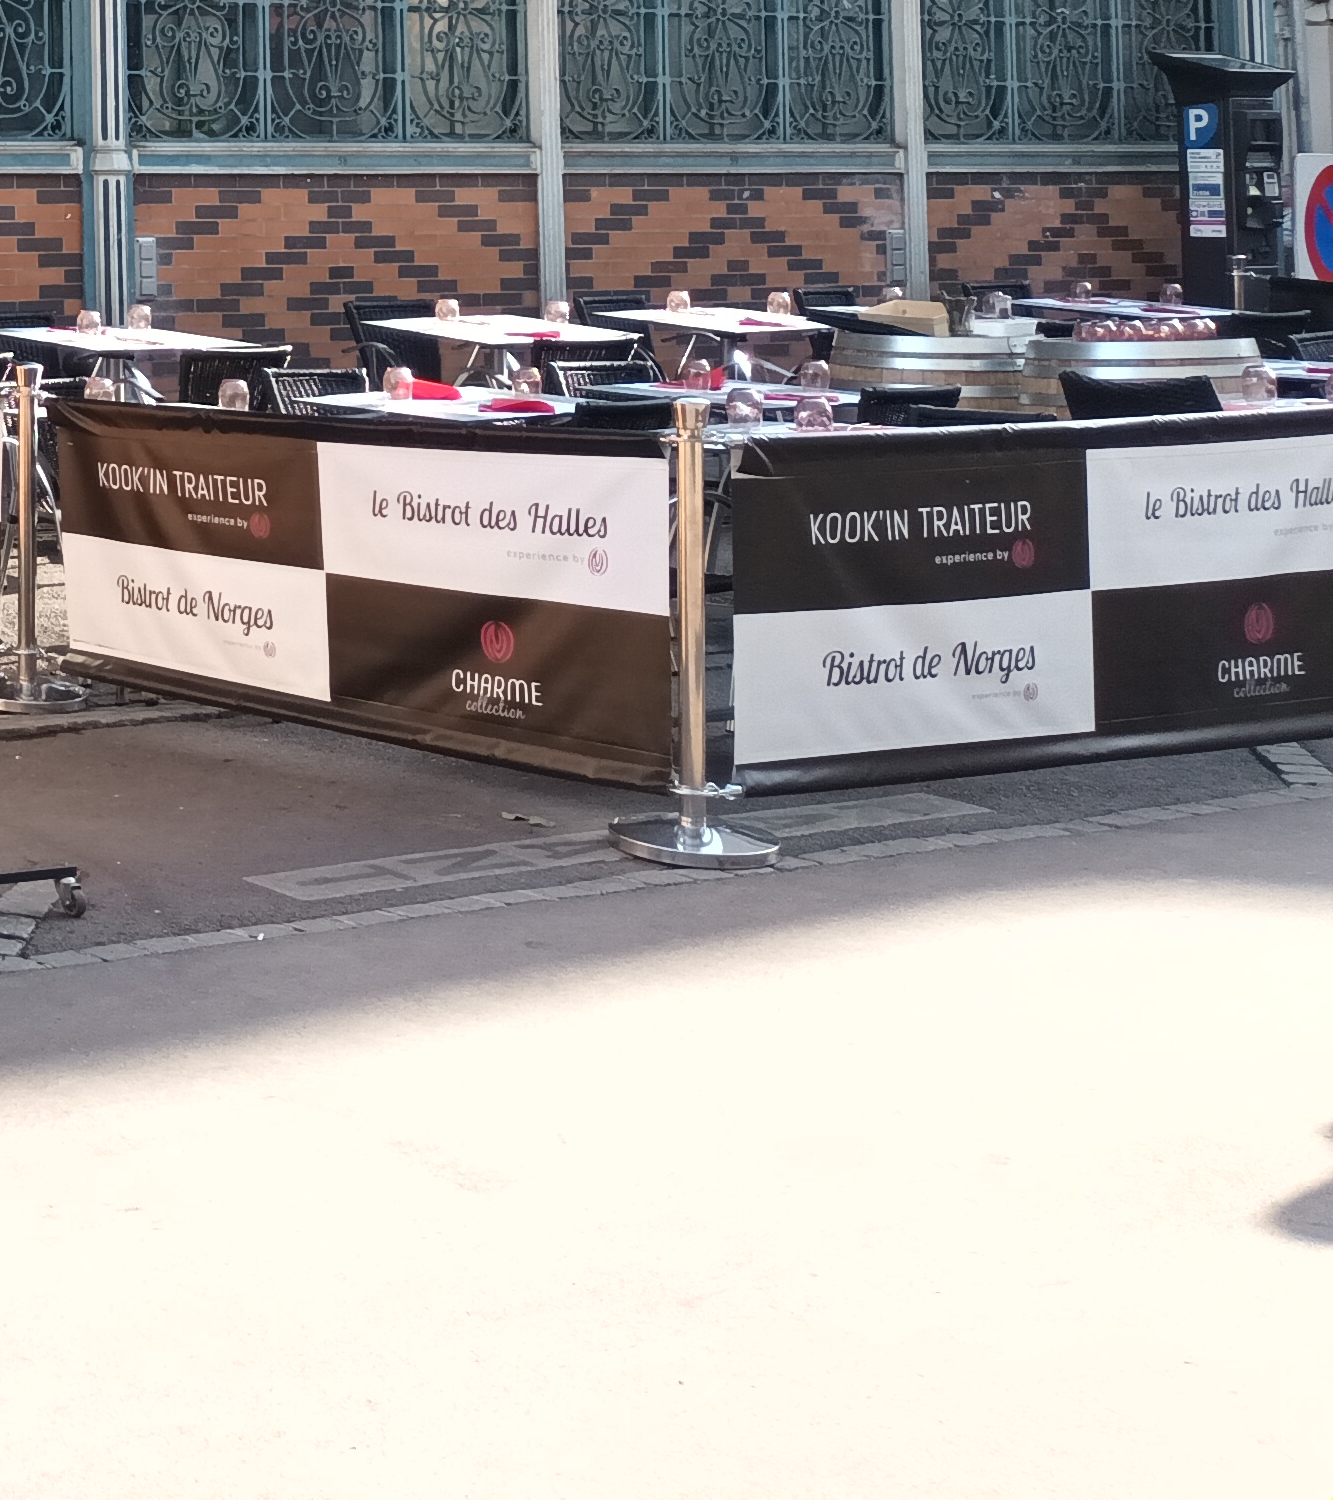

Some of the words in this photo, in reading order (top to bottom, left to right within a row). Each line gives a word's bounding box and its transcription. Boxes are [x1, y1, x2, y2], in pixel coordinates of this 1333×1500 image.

[1189, 108, 1209, 140] P
[97, 461, 169, 496] KOOK'IN
[172, 470, 268, 507] TRAITEUR
[1144, 491, 1162, 520] le
[1170, 486, 1241, 519] Bistrot
[1247, 483, 1282, 512] des
[1289, 478, 1333, 509] Hall
[187, 512, 235, 526] experience
[236, 517, 248, 530] by
[371, 490, 389, 518] le
[396, 490, 472, 527] Bistrot
[479, 501, 517, 532] des
[528, 502, 608, 539] Halles
[809, 509, 909, 546] KOOK'IN
[917, 500, 1032, 538] TRAITEUR
[506, 549, 569, 563] experience
[572, 553, 585, 566] by
[934, 550, 994, 566] experience
[996, 549, 1009, 562] by
[116, 574, 172, 612] Bistrot
[176, 588, 198, 617] de
[202, 590, 274, 637] Norges
[822, 650, 906, 687] Bistrot
[912, 646, 942, 680] de
[952, 640, 1036, 684] Norges
[1218, 652, 1306, 683] CHARME
[451, 669, 543, 706] CHARME
[1233, 678, 1291, 697] collection
[466, 694, 526, 720] collection
